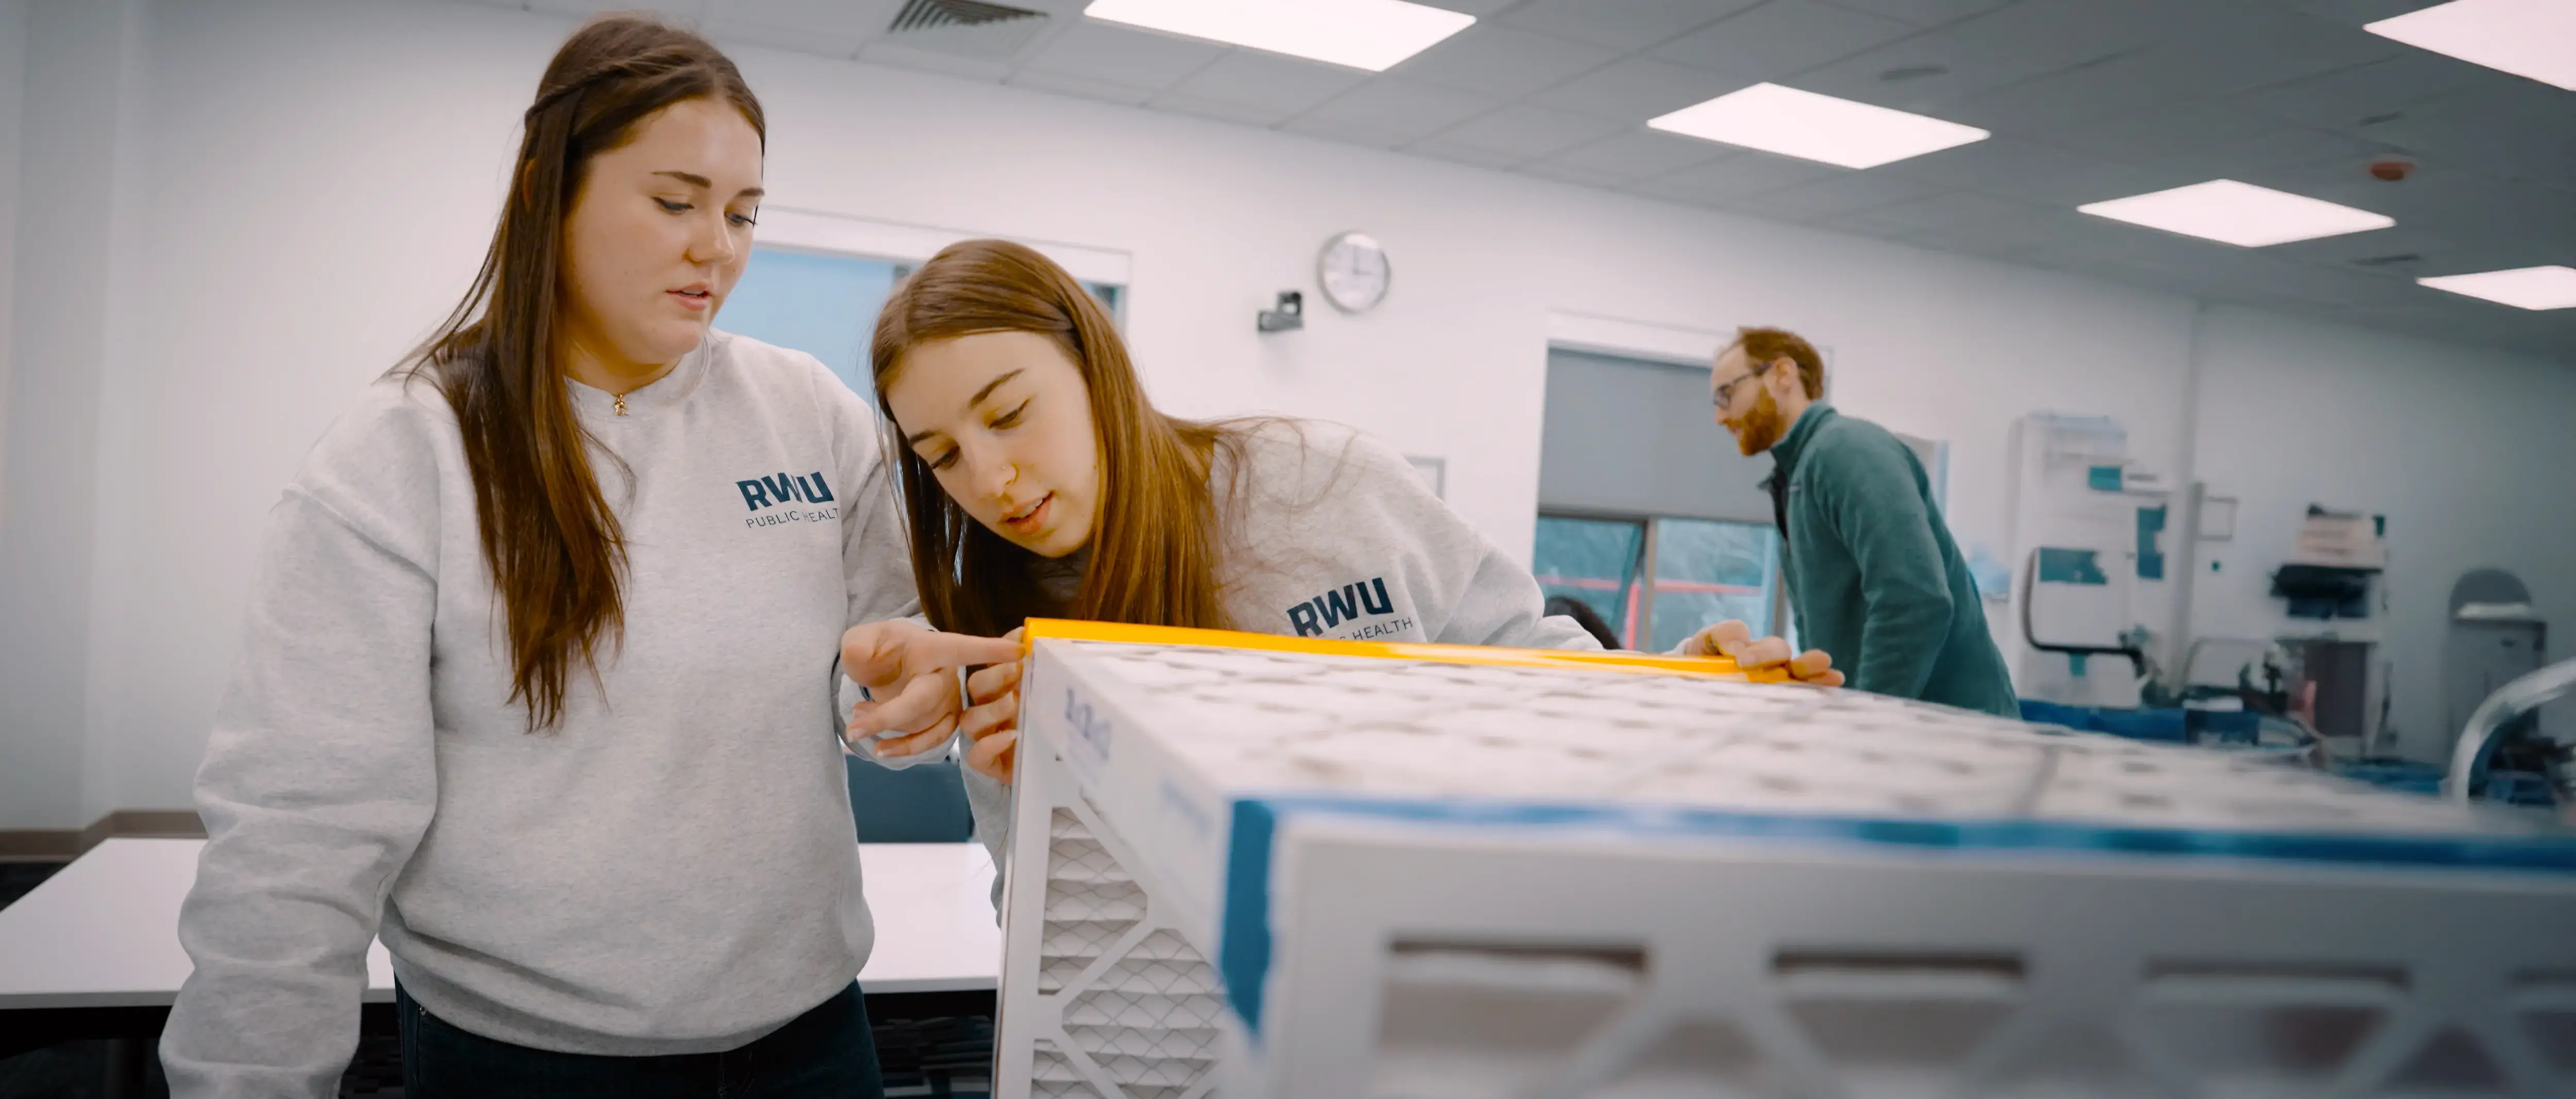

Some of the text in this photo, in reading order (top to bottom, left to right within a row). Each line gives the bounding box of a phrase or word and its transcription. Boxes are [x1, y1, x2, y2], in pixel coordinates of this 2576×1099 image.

[735, 471, 834, 511] RWU
[745, 508, 839, 529] PUBLIC HEALT
[1286, 577, 1394, 637] RWU
[1352, 617, 1413, 640] HEALTH
